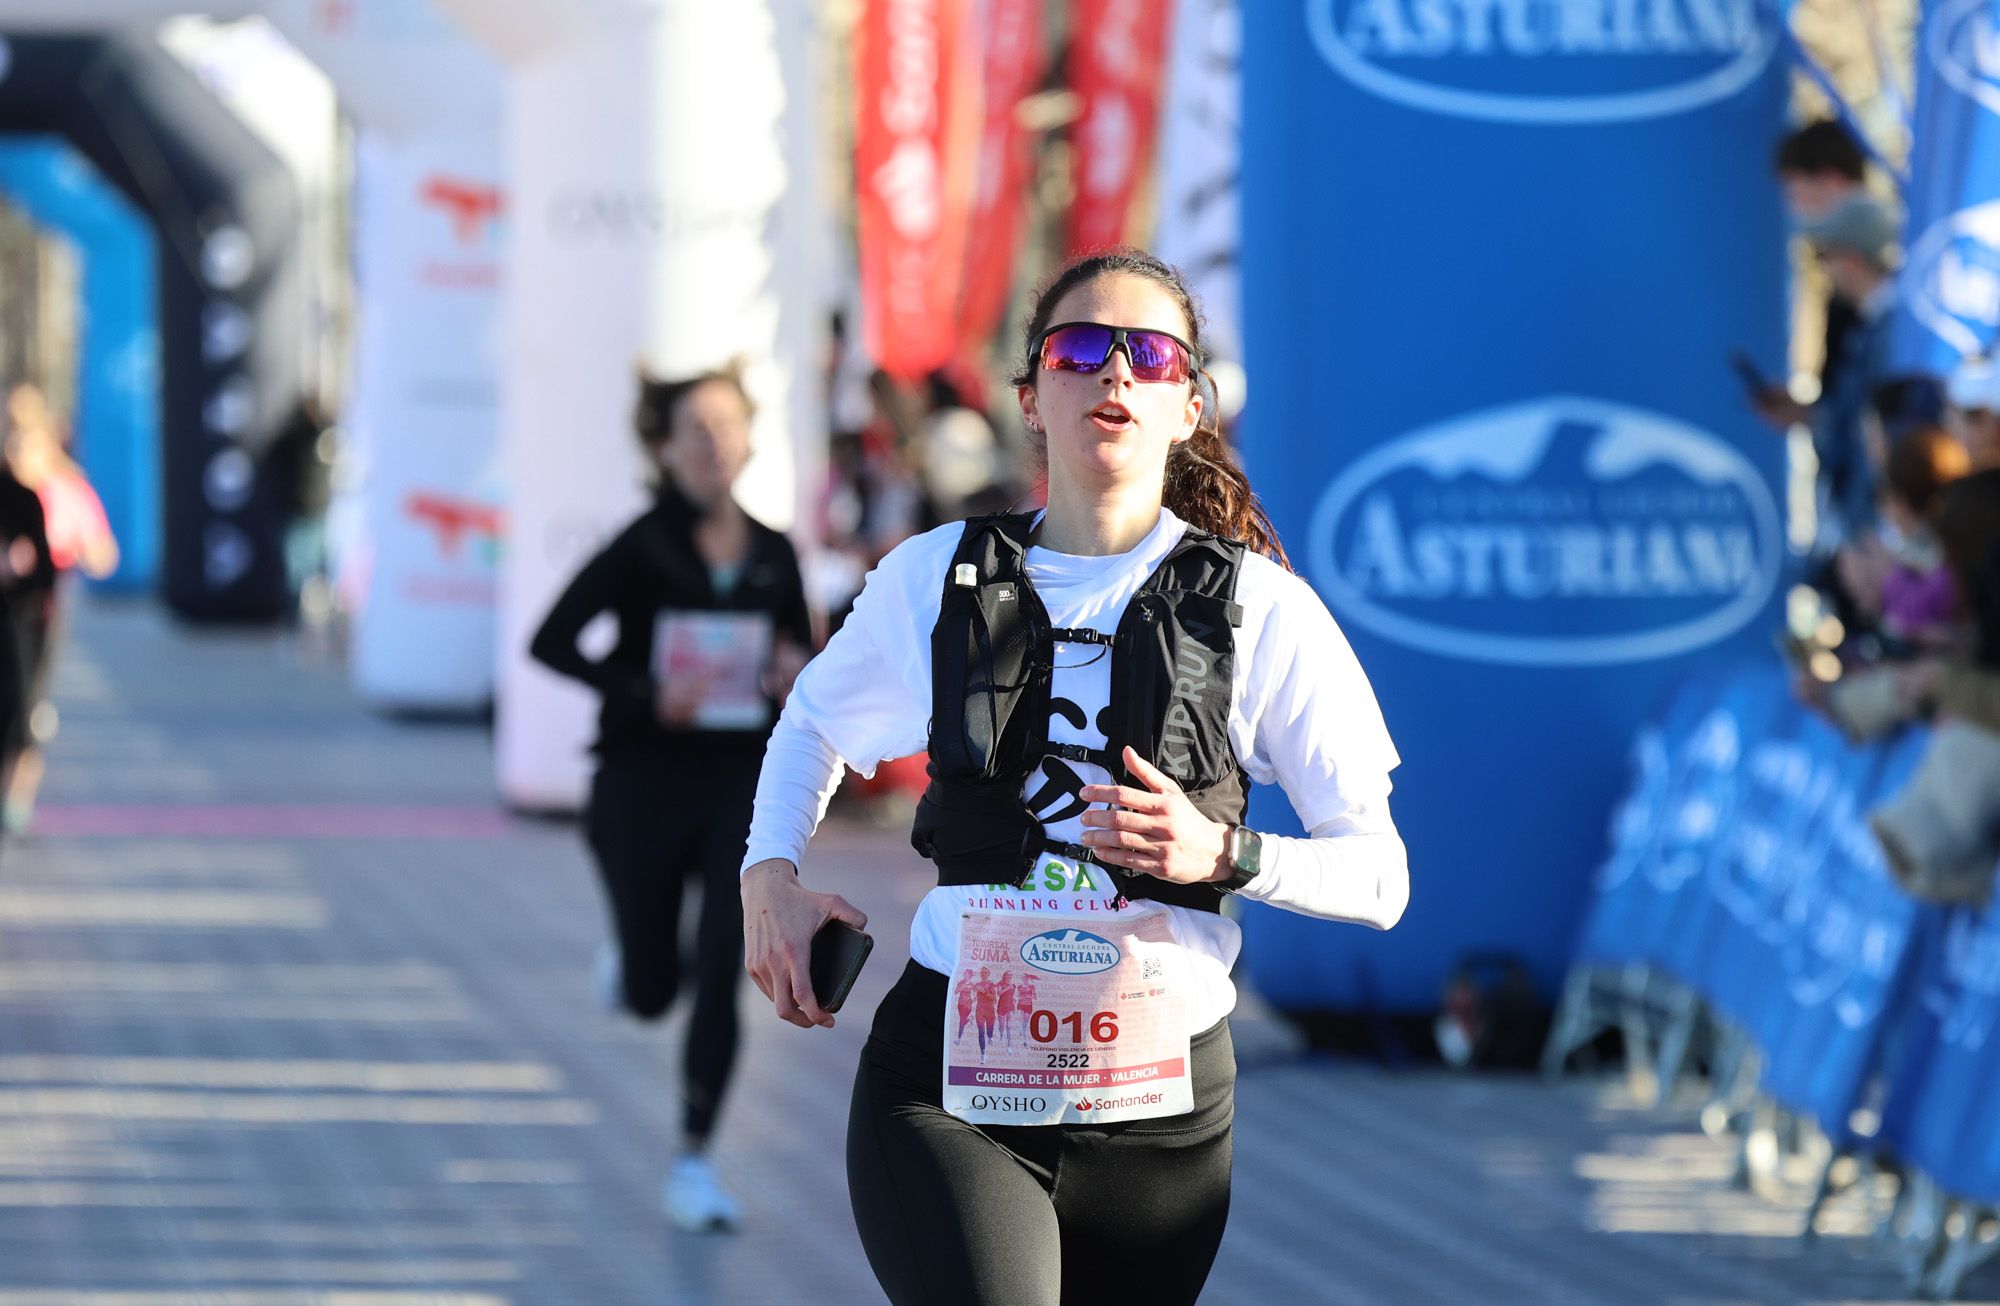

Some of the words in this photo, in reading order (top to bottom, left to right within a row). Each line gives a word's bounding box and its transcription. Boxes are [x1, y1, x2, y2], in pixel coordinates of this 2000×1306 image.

[1161, 618, 1217, 777] KIPRUN
[969, 897, 1058, 911] RUNNING
[1074, 895, 1129, 911] CLUB
[971, 948, 1011, 963] SUMA
[1027, 943, 1114, 965] ASTURIANA
[1042, 942, 1075, 951] CENTRAL
[1029, 1009, 1120, 1044] 016
[1046, 1053, 1090, 1068] 2522
[975, 1071, 1025, 1085] CARRERA
[1028, 1075, 1043, 1085] DE
[1046, 1076, 1060, 1086] LA
[1063, 1074, 1101, 1086] MUJER
[1110, 1066, 1159, 1083] VALENCIA
[971, 1094, 1047, 1113] OYSHO
[1094, 1092, 1164, 1111] Santander
